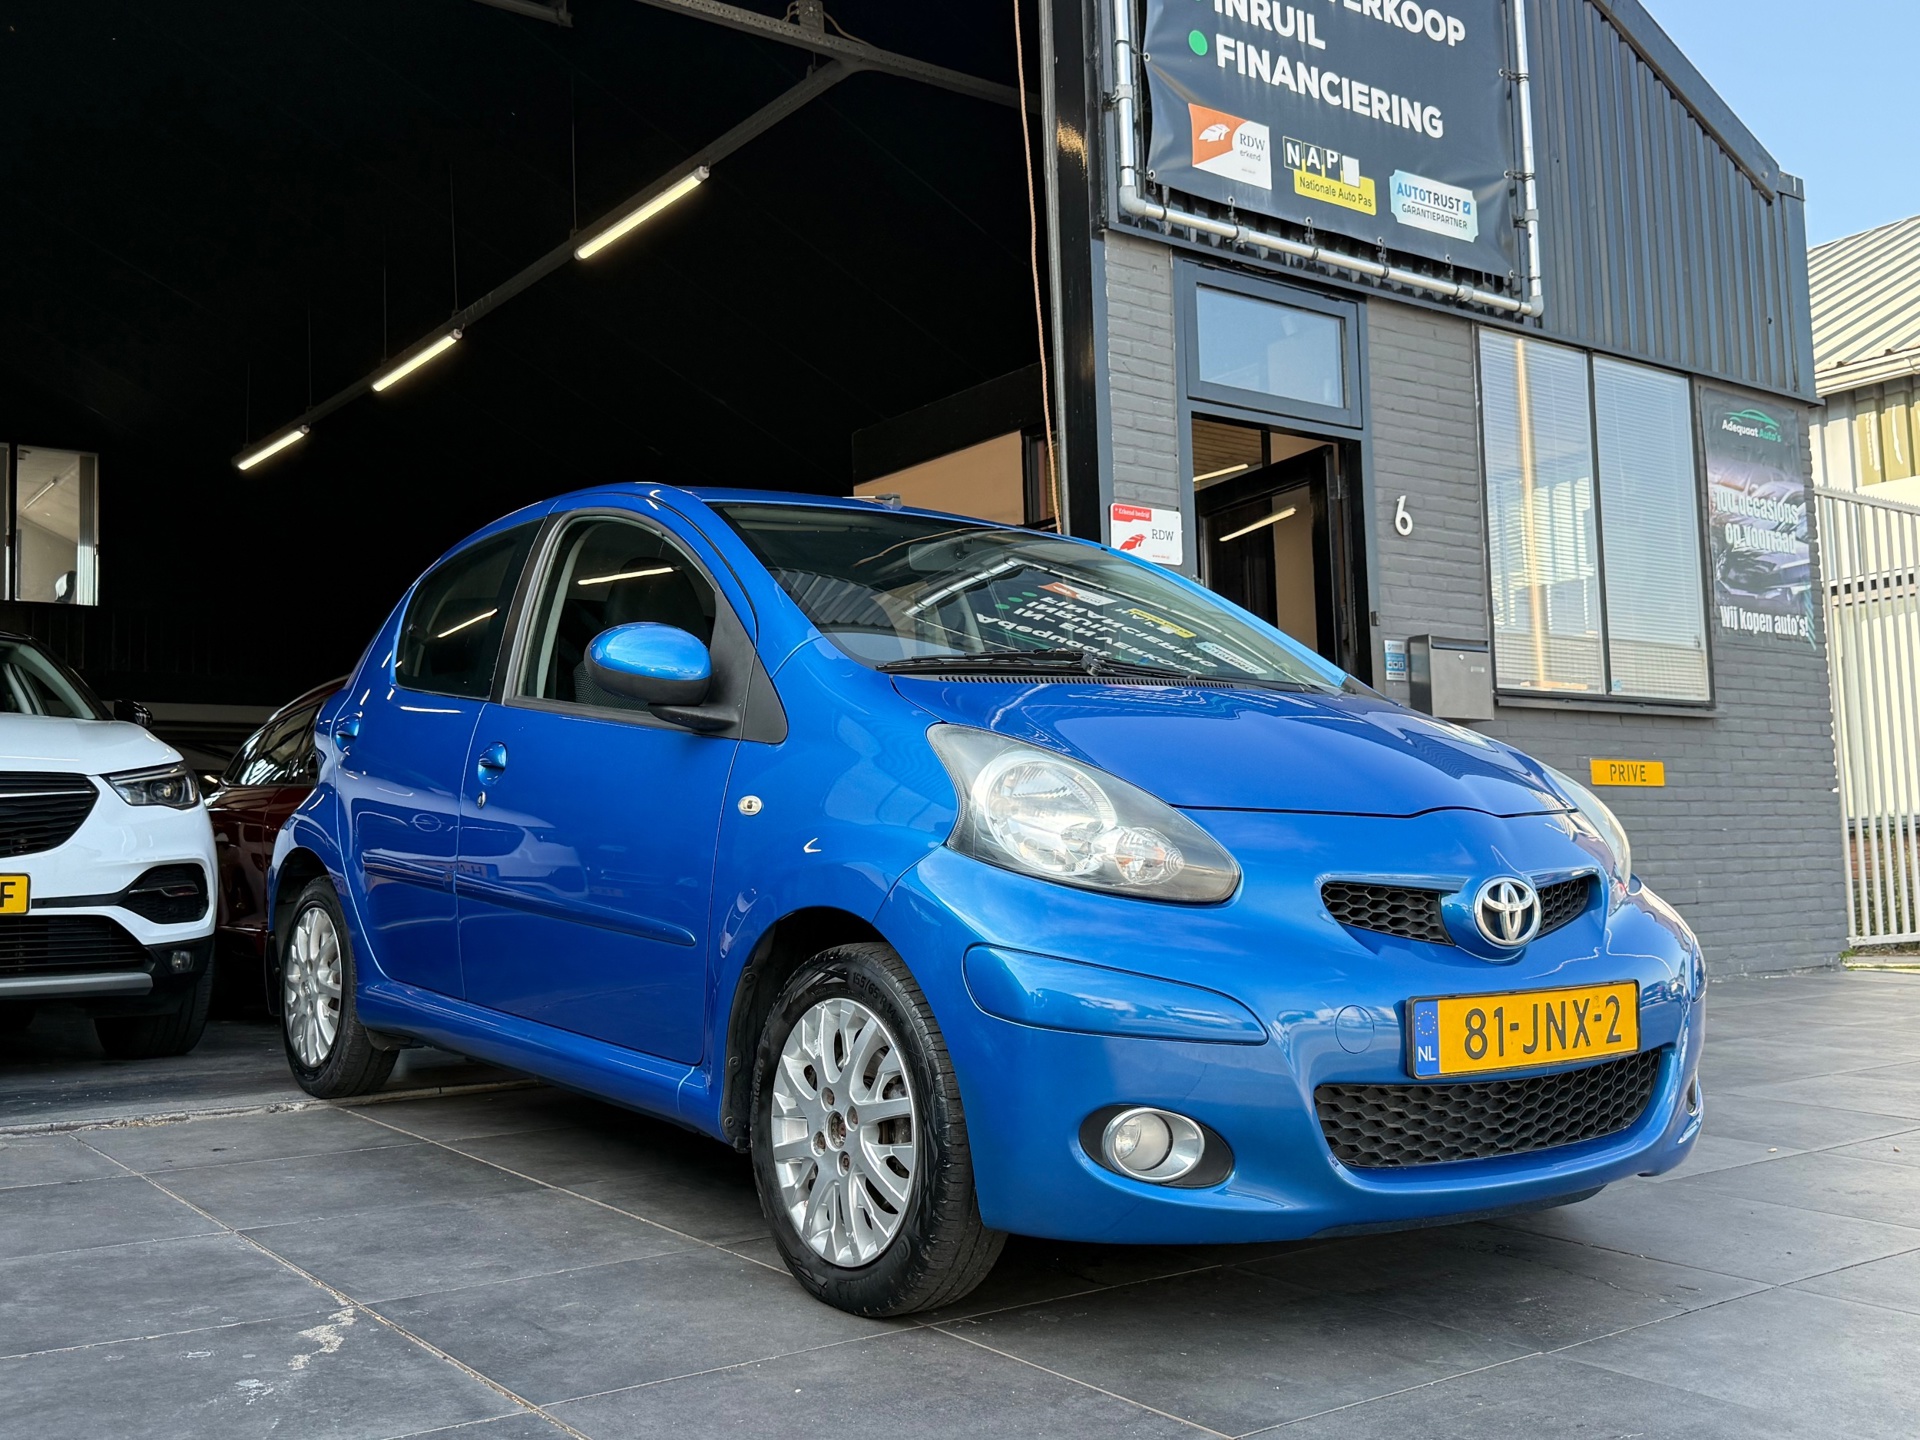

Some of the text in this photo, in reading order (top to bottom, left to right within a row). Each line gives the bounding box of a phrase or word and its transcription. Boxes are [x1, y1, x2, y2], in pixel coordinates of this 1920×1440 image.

[1328, 0, 1465, 46] RKOOP
[1216, 33, 1443, 138] FINANCIERING
[1240, 133, 1265, 151] RDW
[1287, 143, 1339, 169] NAP
[1300, 177, 1372, 207] Nationale Auto Pas
[1397, 183, 1461, 212] AUTOTRUST
[1402, 204, 1467, 229] GARANTIEPARTNER
[1722, 419, 1781, 442] Adequaat Auto's
[1395, 495, 1413, 536] 6
[1739, 495, 1799, 525] occasions
[1151, 528, 1174, 541] RDW
[1725, 522, 1742, 548] op
[1720, 605, 1809, 637] Wij kopen auto's!
[1609, 764, 1647, 782] PRIVE
[1464, 995, 1621, 1060] 81-JNX-2
[1418, 1045, 1436, 1062] NL
